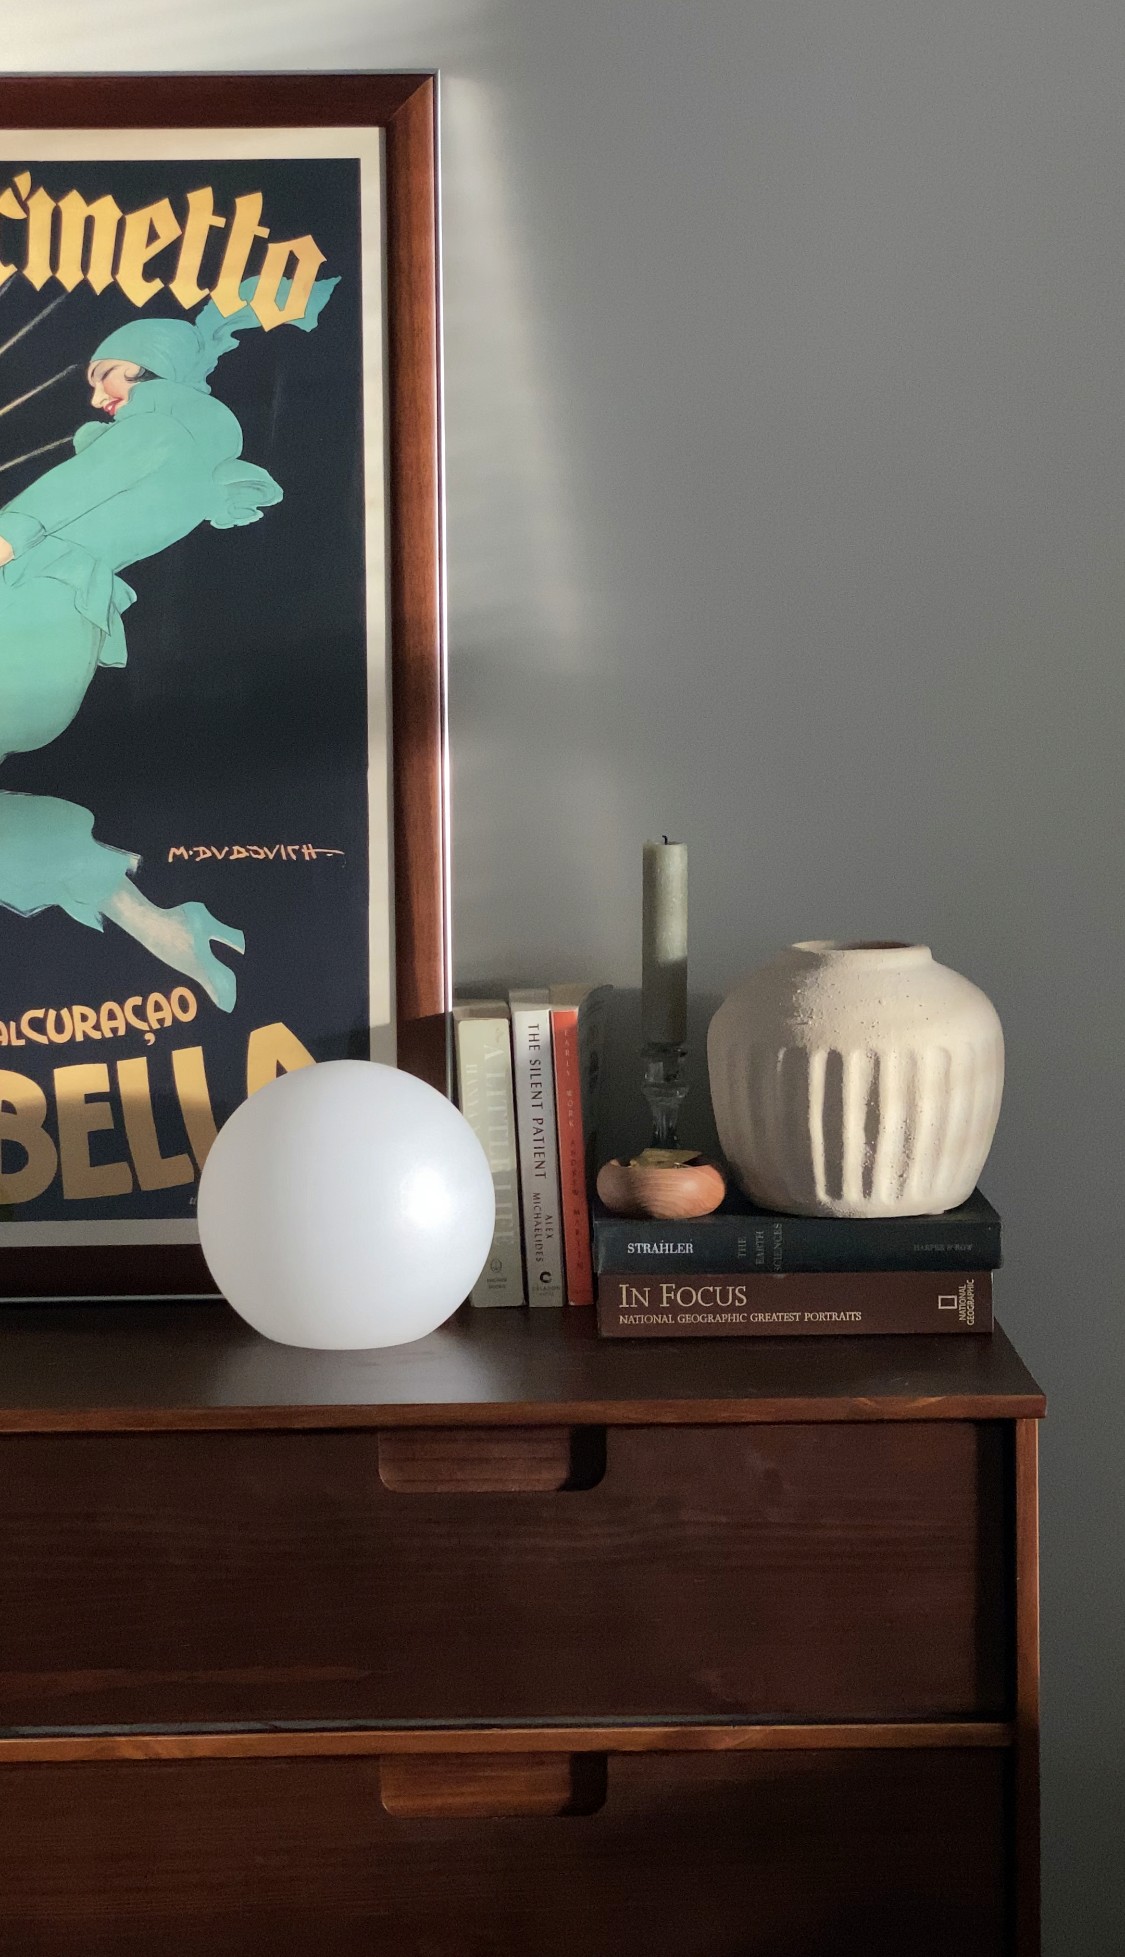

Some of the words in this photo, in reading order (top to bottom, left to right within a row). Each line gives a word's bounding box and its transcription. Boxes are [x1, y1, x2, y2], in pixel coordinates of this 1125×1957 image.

[20, 986, 198, 1046] CURAÇAO
[484, 1044, 505, 1060] A
[527, 1023, 541, 1051] THE
[529, 1059, 545, 1110] SILENT
[486, 1073, 510, 1171] LITTLE
[531, 1117, 547, 1179] PATIENT
[532, 1191, 545, 1263] MICHAELIDES
[544, 1214, 554, 1240] ALEX
[627, 1242, 694, 1254] STRAHLER
[755, 1230, 765, 1265] EARTH
[773, 1222, 783, 1272] SCIENCES
[618, 1284, 651, 1308] IN
[659, 1283, 747, 1307] FOCUS
[958, 1284, 967, 1321] NATIONAL
[966, 1279, 975, 1326] GEOGRAPHIC
[619, 1314, 675, 1325] NATIONAL
[677, 1313, 747, 1324] GEOGRAPHIC
[750, 1312, 802, 1322] GREATEST
[804, 1311, 862, 1322] PORTRAITS
